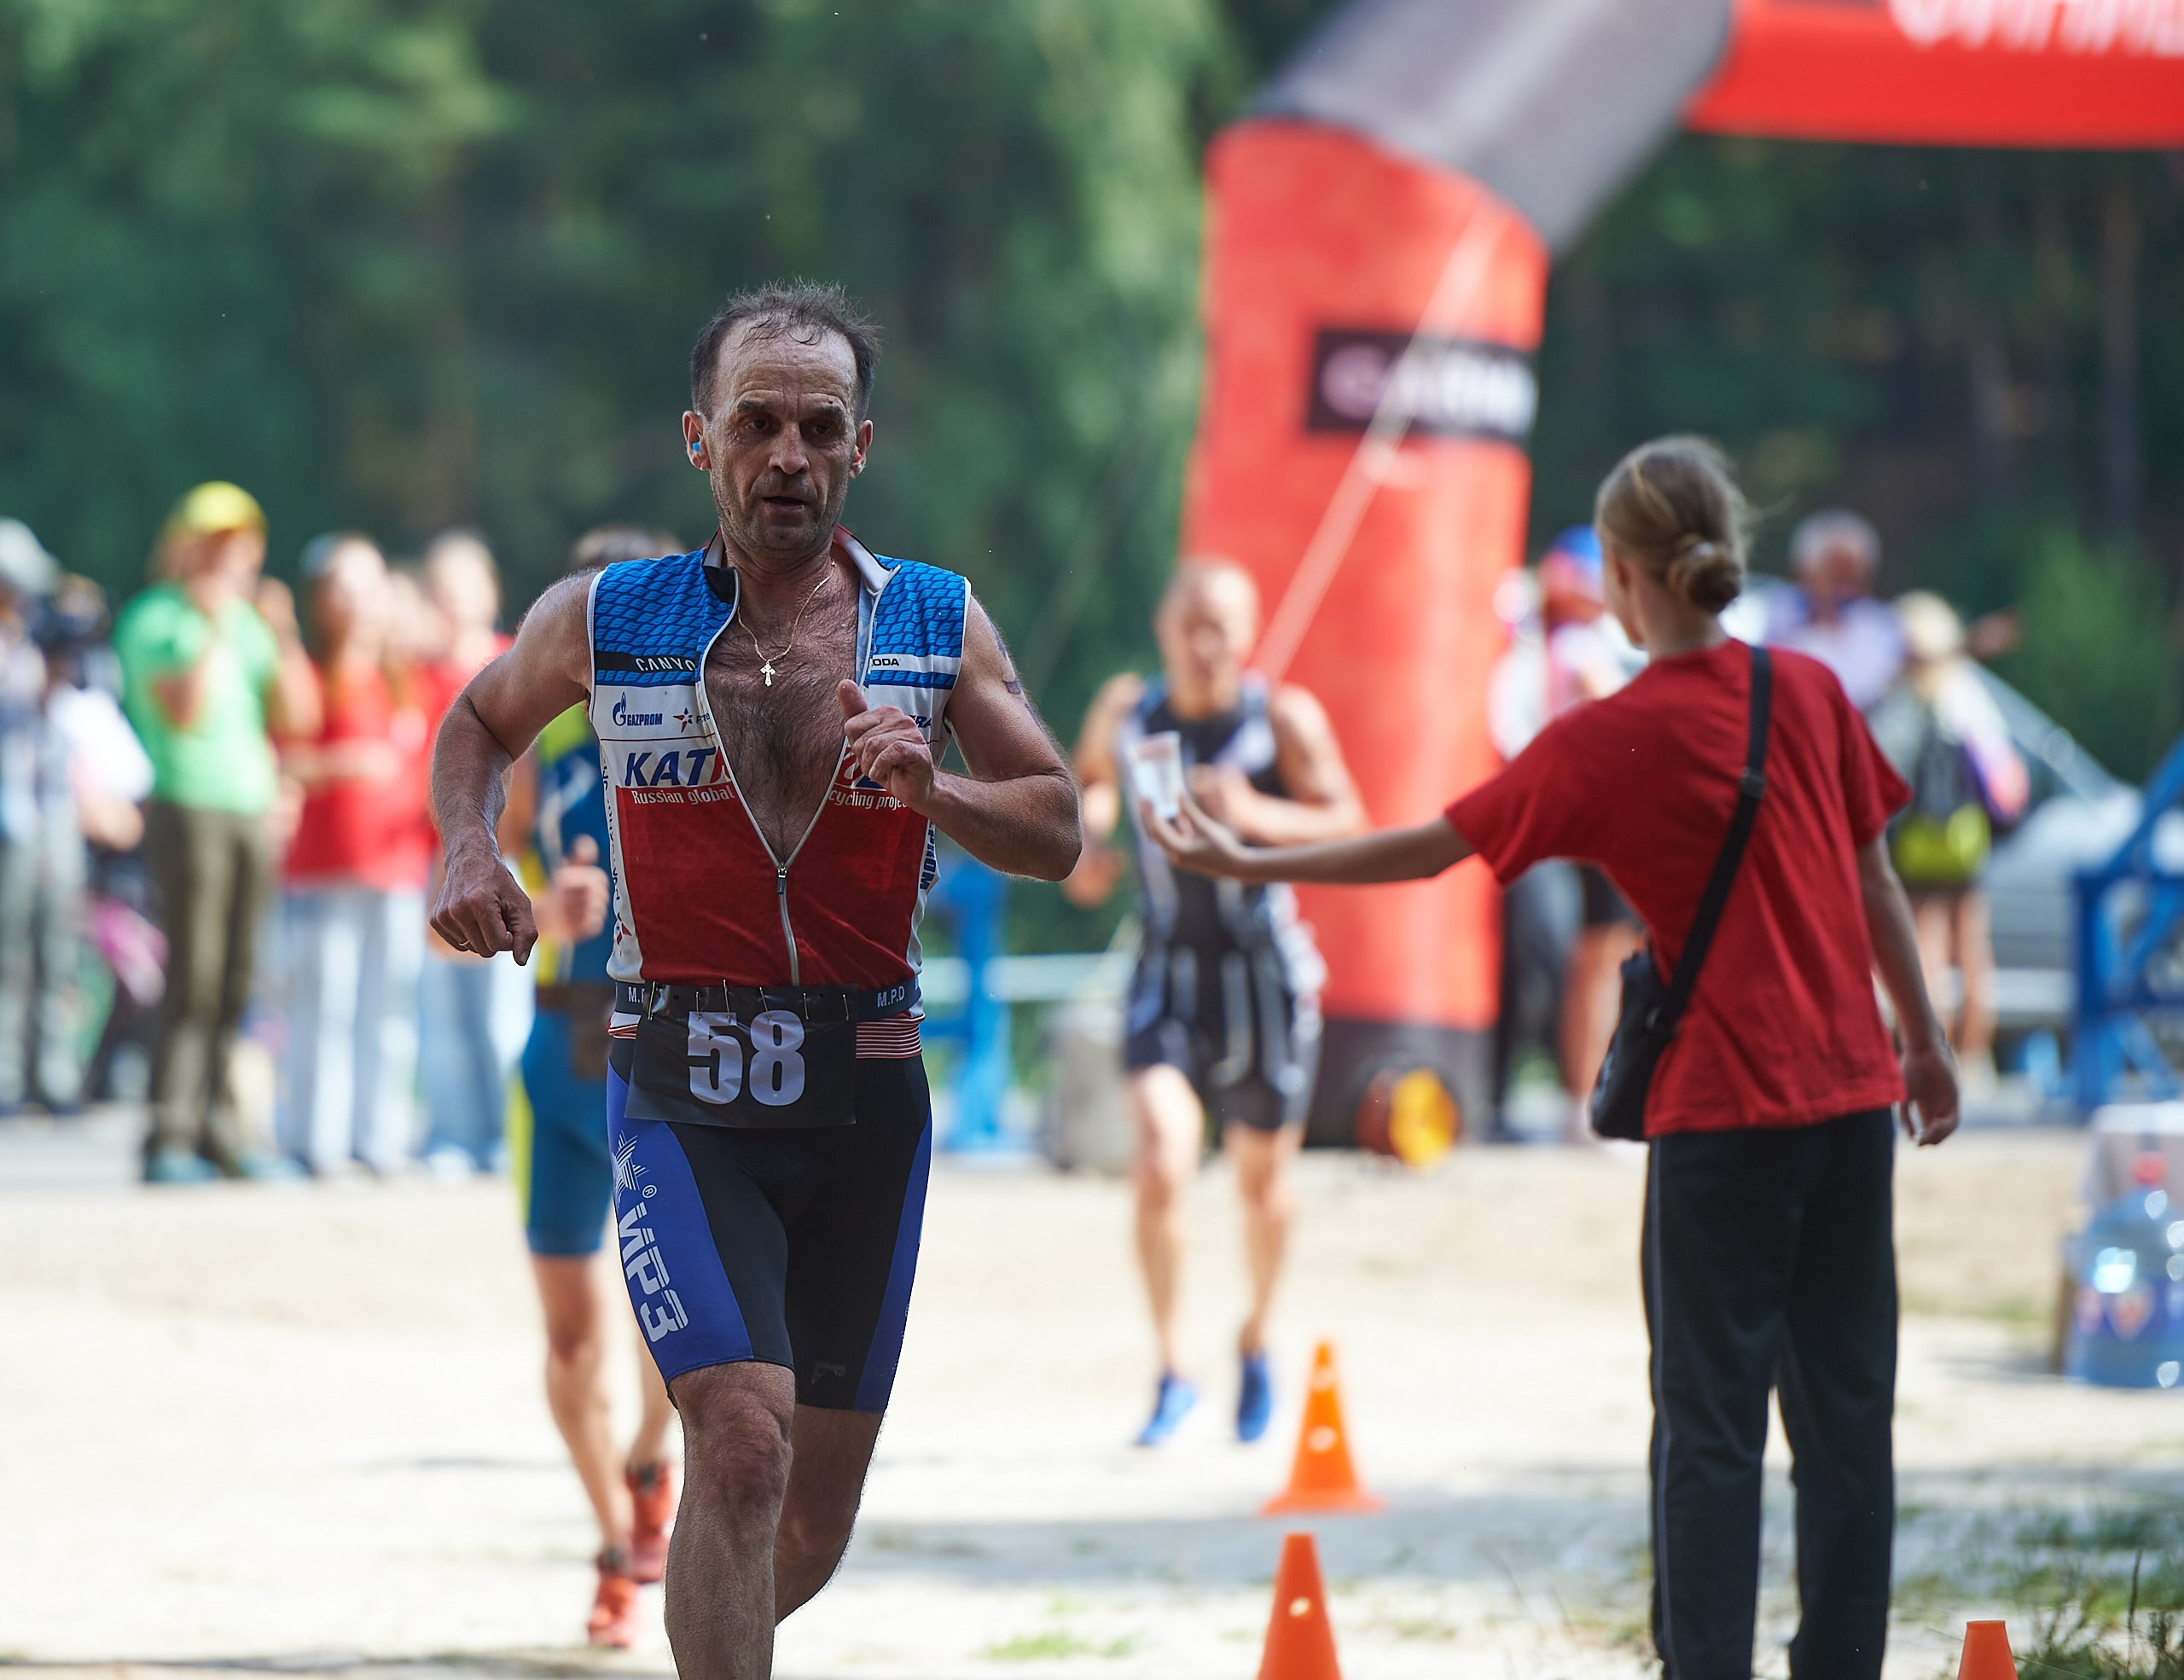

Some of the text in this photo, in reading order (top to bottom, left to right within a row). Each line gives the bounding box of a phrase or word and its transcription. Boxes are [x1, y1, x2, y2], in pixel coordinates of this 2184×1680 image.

[871, 658, 900, 667] ODA
[626, 712, 663, 726] GAZPROM
[631, 790, 684, 805] Russian
[688, 784, 735, 805] global
[828, 789, 875, 810] cycling
[877, 985, 905, 1008] M.P.D
[687, 1009, 805, 1107] 58
